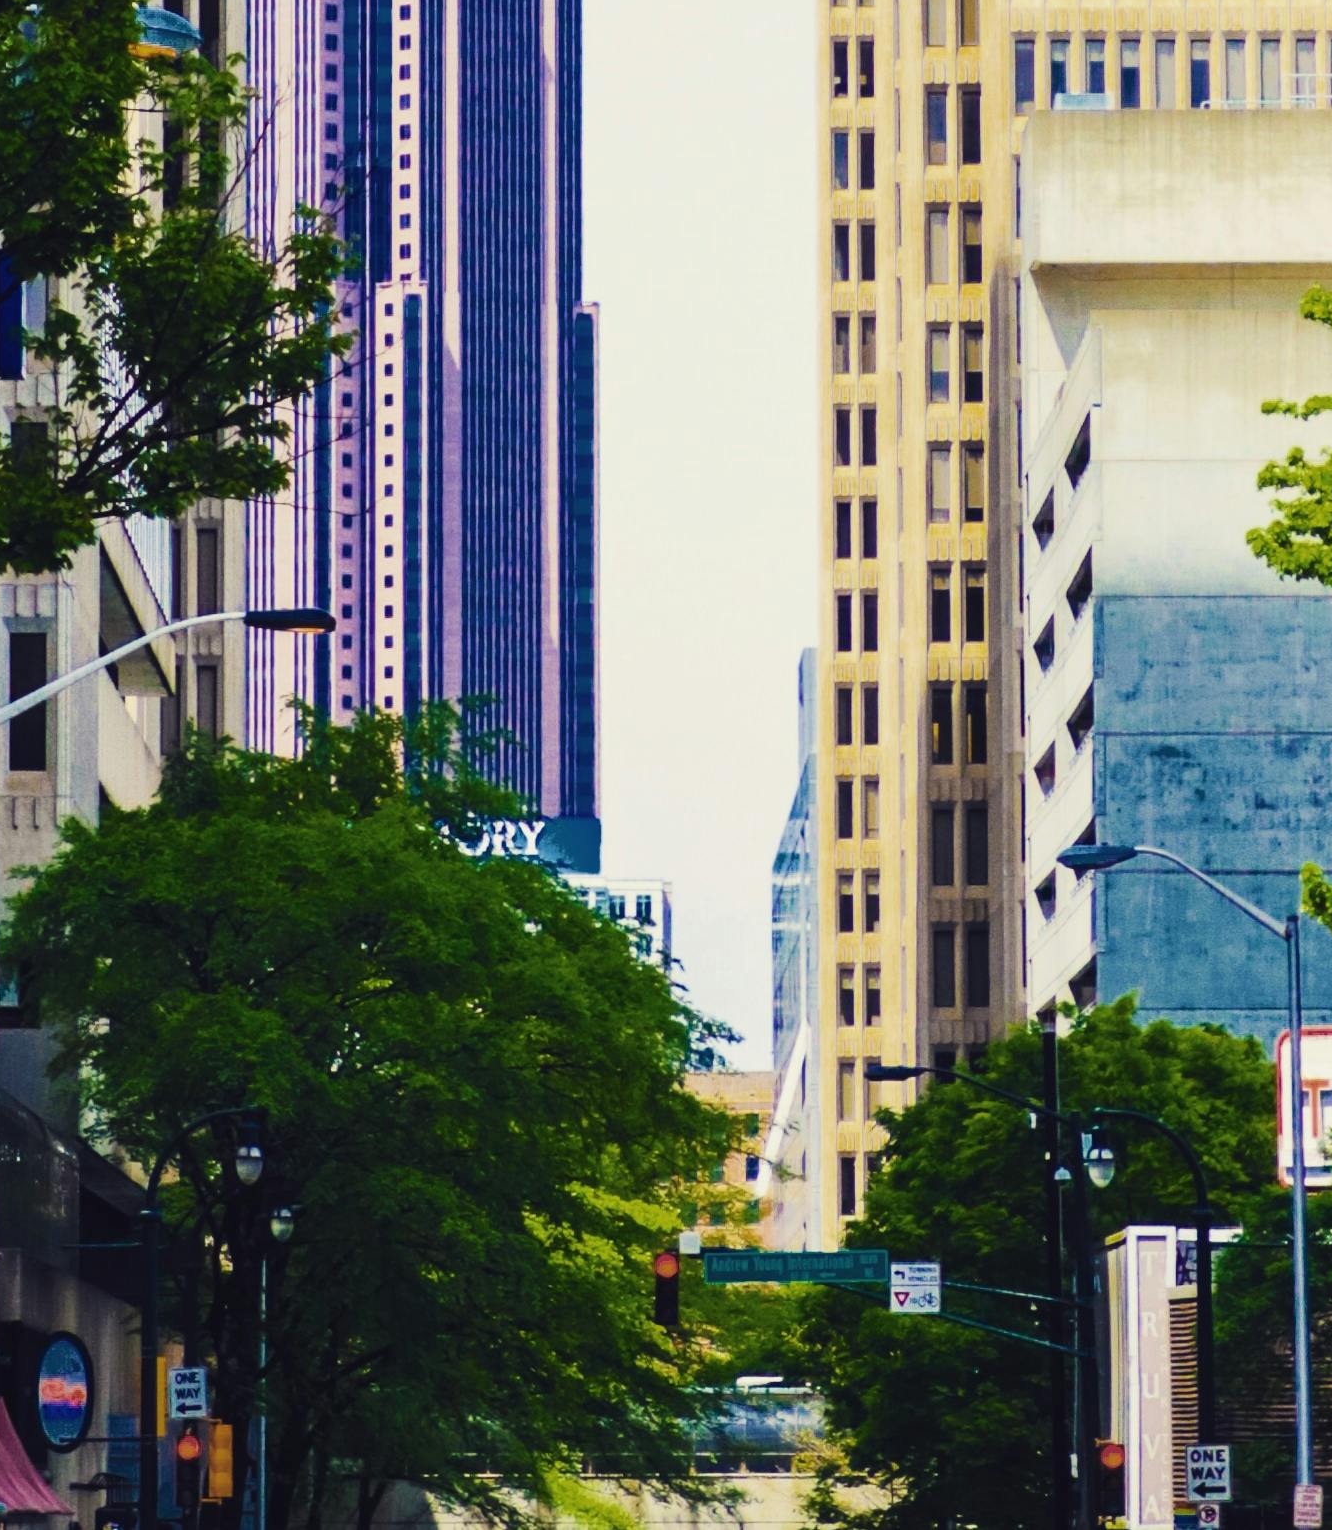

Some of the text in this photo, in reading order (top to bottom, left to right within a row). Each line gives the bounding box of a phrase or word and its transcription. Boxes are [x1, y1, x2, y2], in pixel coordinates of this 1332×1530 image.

[711, 1257, 749, 1272] Andrew
[754, 1257, 783, 1275] Young
[787, 1254, 854, 1270] International
[175, 1372, 200, 1384] ONE
[1142, 1251, 1162, 1520] TRUVA
[174, 1388, 201, 1400] WAY
[1190, 1449, 1225, 1462] ONE
[1190, 1466, 1226, 1480] WAY
